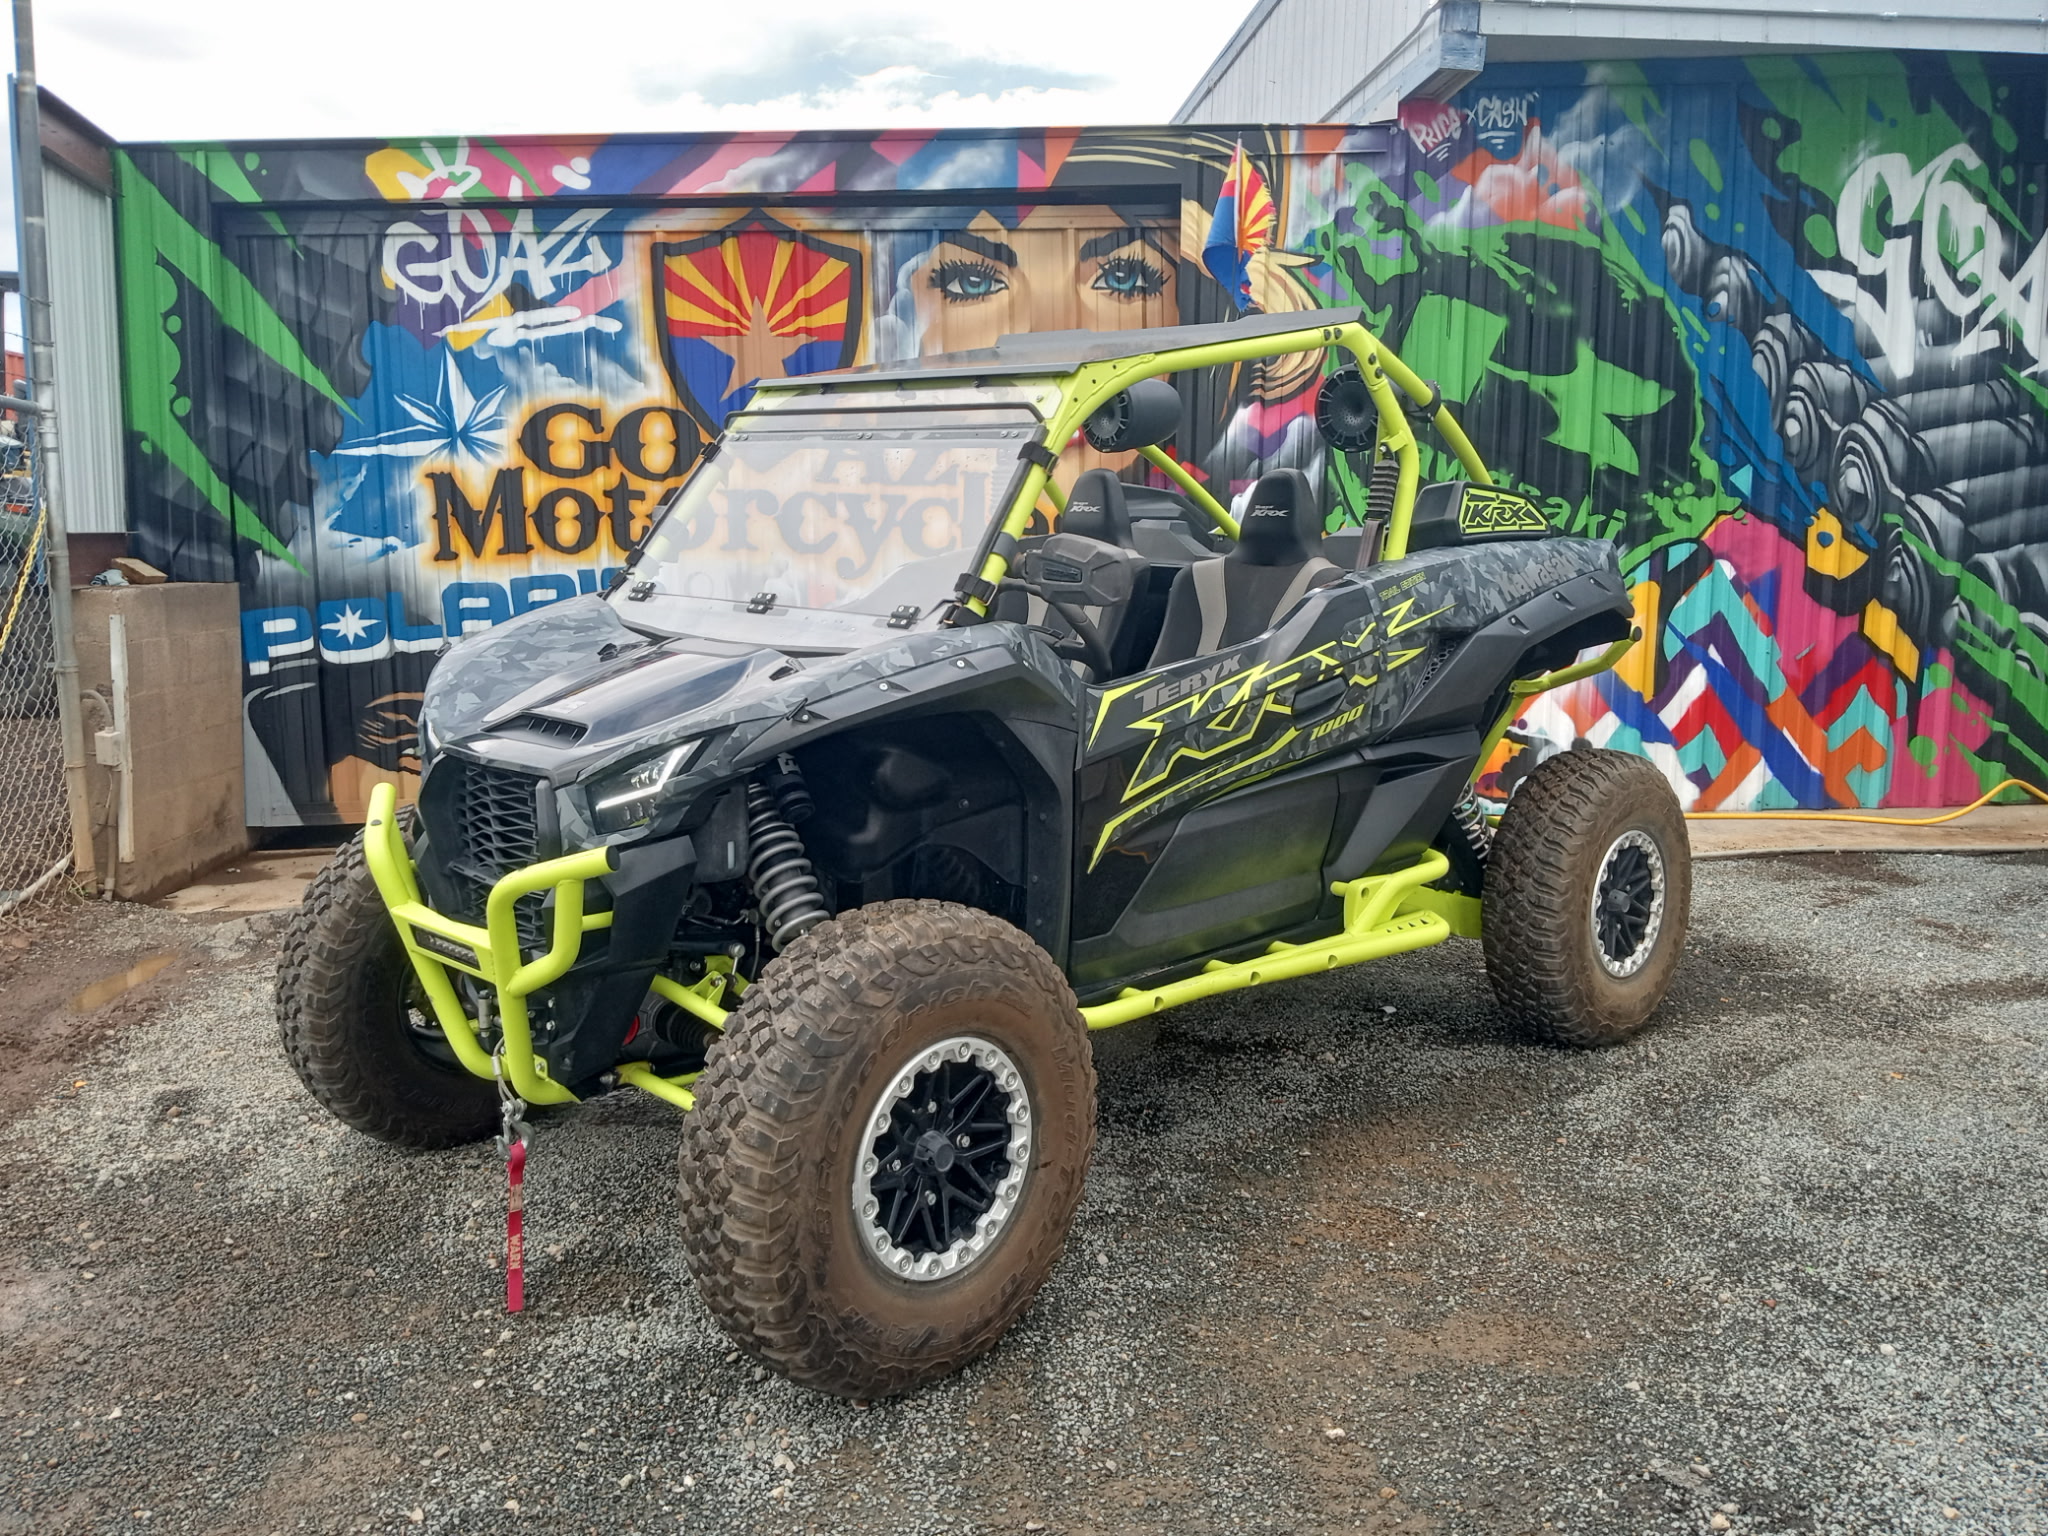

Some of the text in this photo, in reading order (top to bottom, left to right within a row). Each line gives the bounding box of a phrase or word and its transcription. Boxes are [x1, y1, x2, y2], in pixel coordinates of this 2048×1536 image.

[518, 403, 704, 482] GO
[426, 466, 1062, 580] Motorcycl
[1069, 505, 1102, 513] KRX
[1250, 509, 1289, 517] KRX
[1468, 503, 1528, 523] KRX
[1310, 704, 1366, 741] 1000
[509, 1233, 522, 1270] WARN
